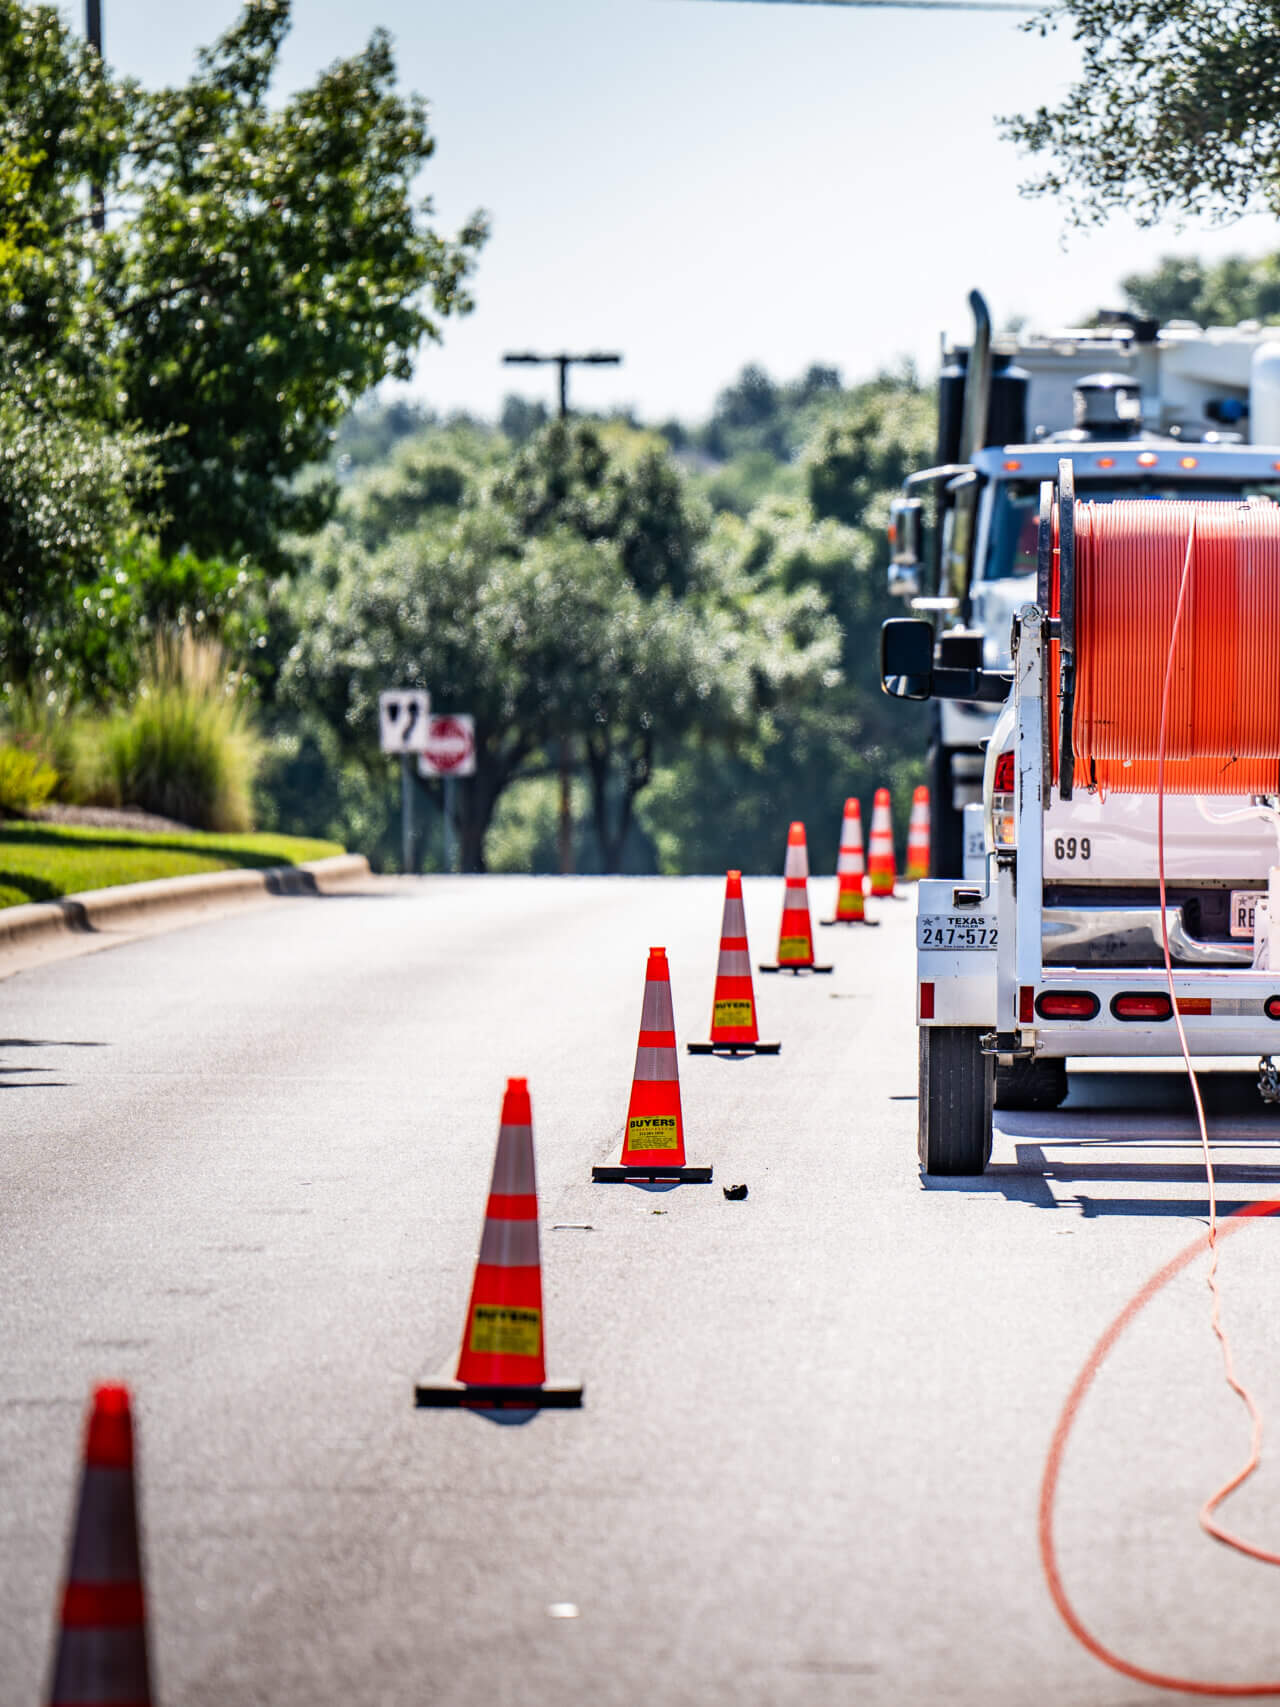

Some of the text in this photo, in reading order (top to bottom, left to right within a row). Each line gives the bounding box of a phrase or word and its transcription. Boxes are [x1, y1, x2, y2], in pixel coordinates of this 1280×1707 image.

[1054, 837, 1091, 860] 699
[947, 917, 985, 925] TEXAS
[630, 1119, 675, 1128] BUYERS
